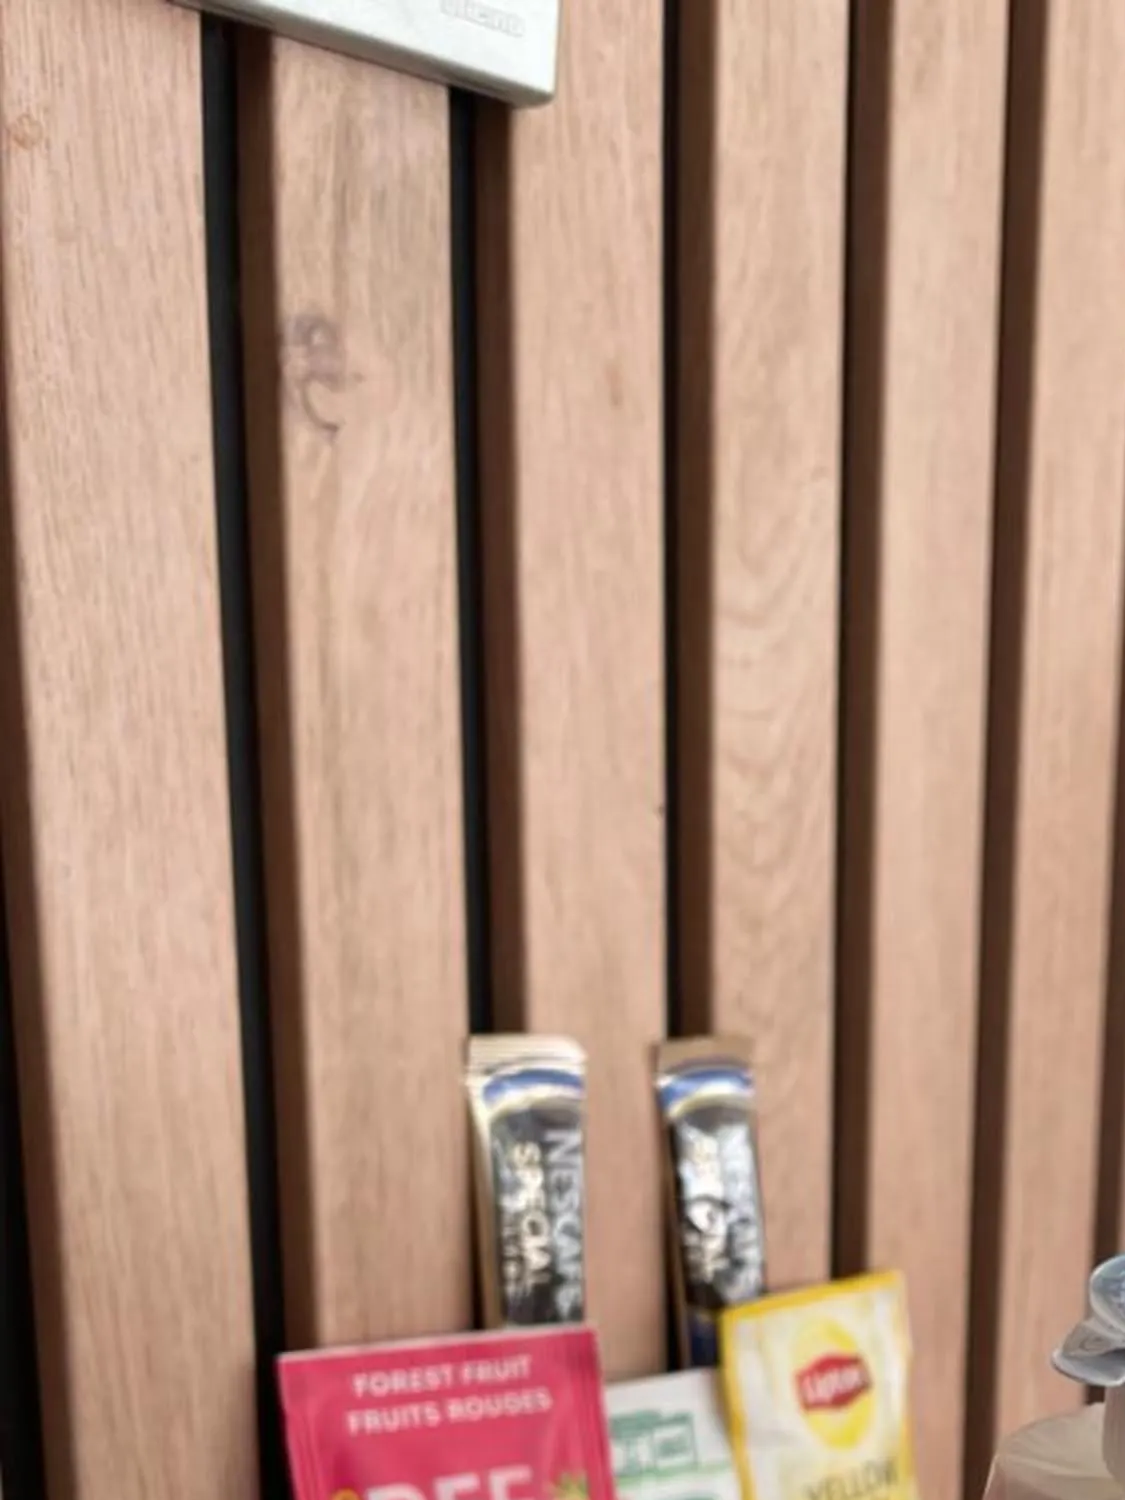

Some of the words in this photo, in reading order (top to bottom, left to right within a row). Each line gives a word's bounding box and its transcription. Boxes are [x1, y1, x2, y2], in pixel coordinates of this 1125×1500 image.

[353, 1364, 455, 1398] FOREST
[460, 1354, 532, 1385] FRUIT
[346, 1404, 440, 1434] FRUITS
[448, 1387, 553, 1422] ROUGES
